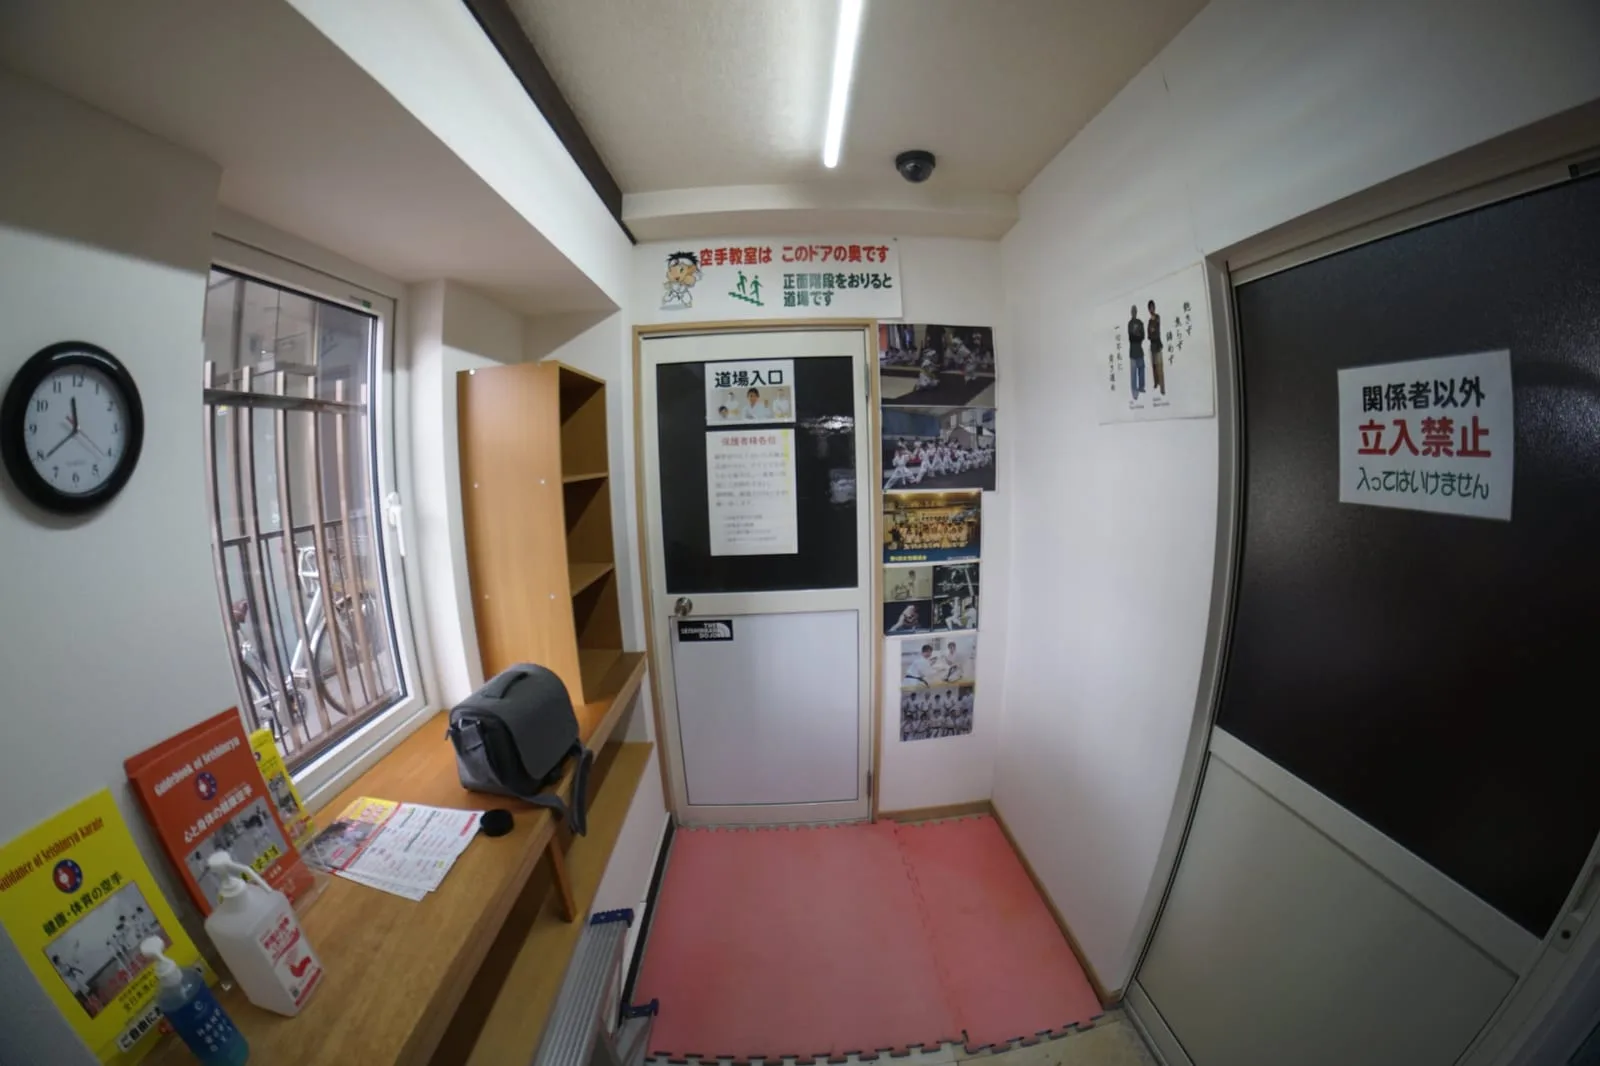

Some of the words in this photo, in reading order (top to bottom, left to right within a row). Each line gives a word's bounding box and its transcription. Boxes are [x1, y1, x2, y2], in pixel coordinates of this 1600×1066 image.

[700, 247, 772, 267] 空手教室は
[782, 245, 889, 264] このドアの奥です
[783, 273, 893, 290] 正面階段をおりると
[783, 290, 835, 307] 道場です
[72, 376, 85, 388] 12
[714, 370, 783, 388] 道場入口
[52, 381, 62, 394] 11
[1362, 375, 1486, 413] 関係者以外
[36, 400, 48, 413] 10
[107, 401, 114, 412] 2
[29, 424, 37, 435] 9
[111, 423, 118, 434] 3
[1357, 415, 1492, 459] 立入禁止
[36, 450, 45, 461] 8
[52, 466, 59, 479] 7
[92, 464, 99, 476] 5
[72, 472, 80, 483] 6
[1356, 466, 1490, 500] 入ってはいけません
